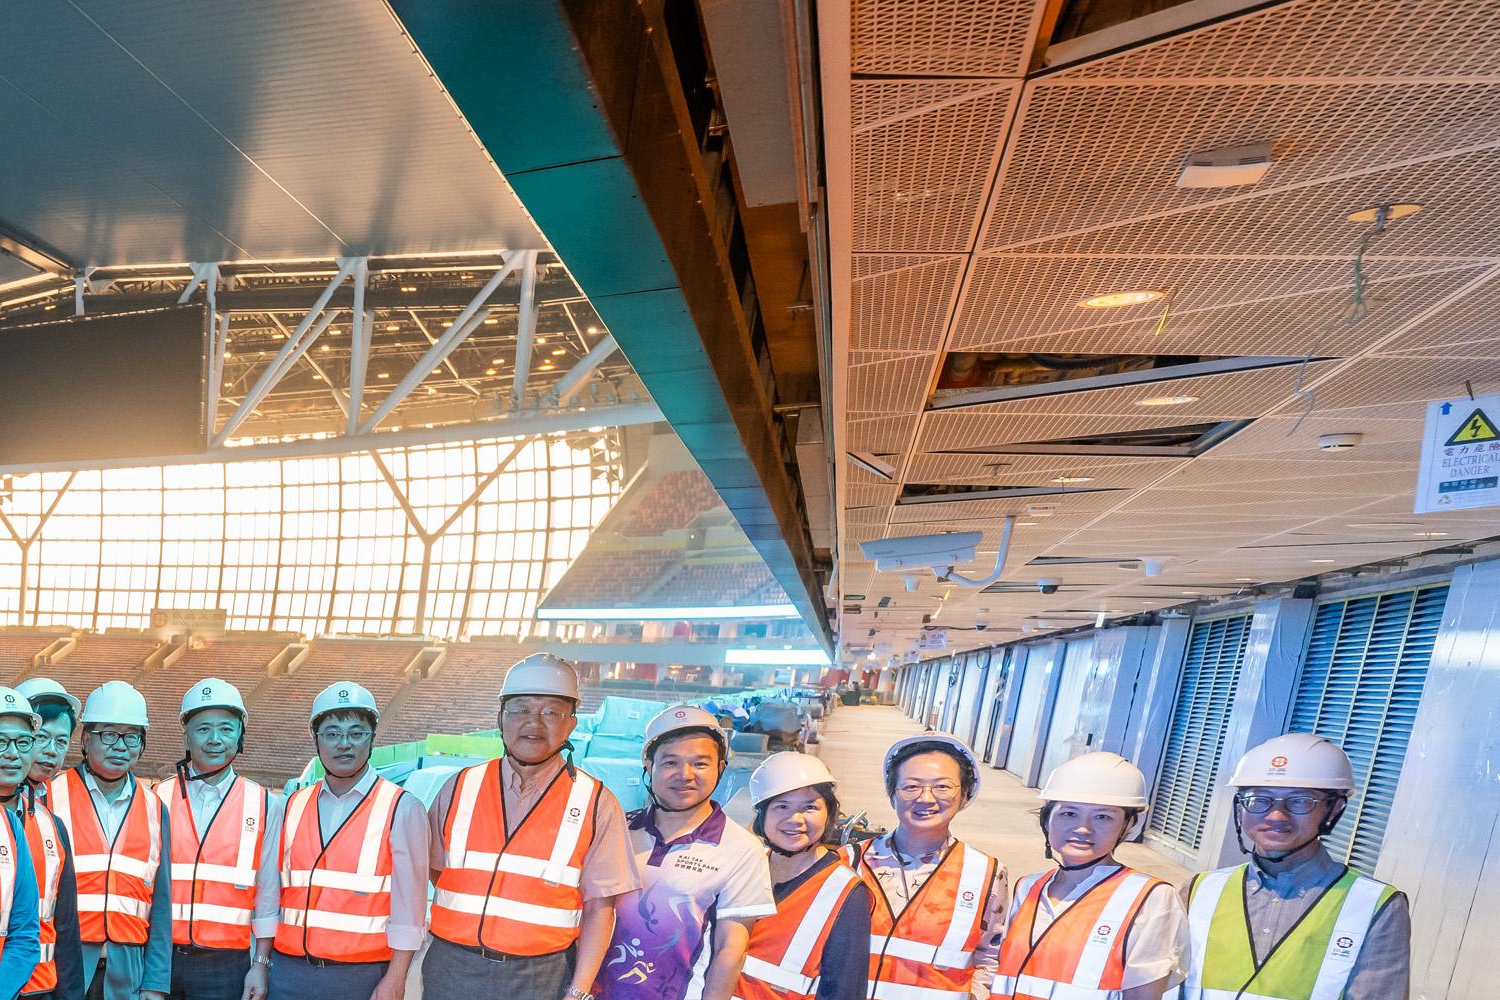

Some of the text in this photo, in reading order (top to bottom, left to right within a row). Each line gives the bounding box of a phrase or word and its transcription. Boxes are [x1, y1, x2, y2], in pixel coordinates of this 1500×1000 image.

[1442, 452, 1500, 468] ELECTRICAL
[1450, 465, 1490, 478] DANGER
[676, 859, 701, 867] SPORTS
